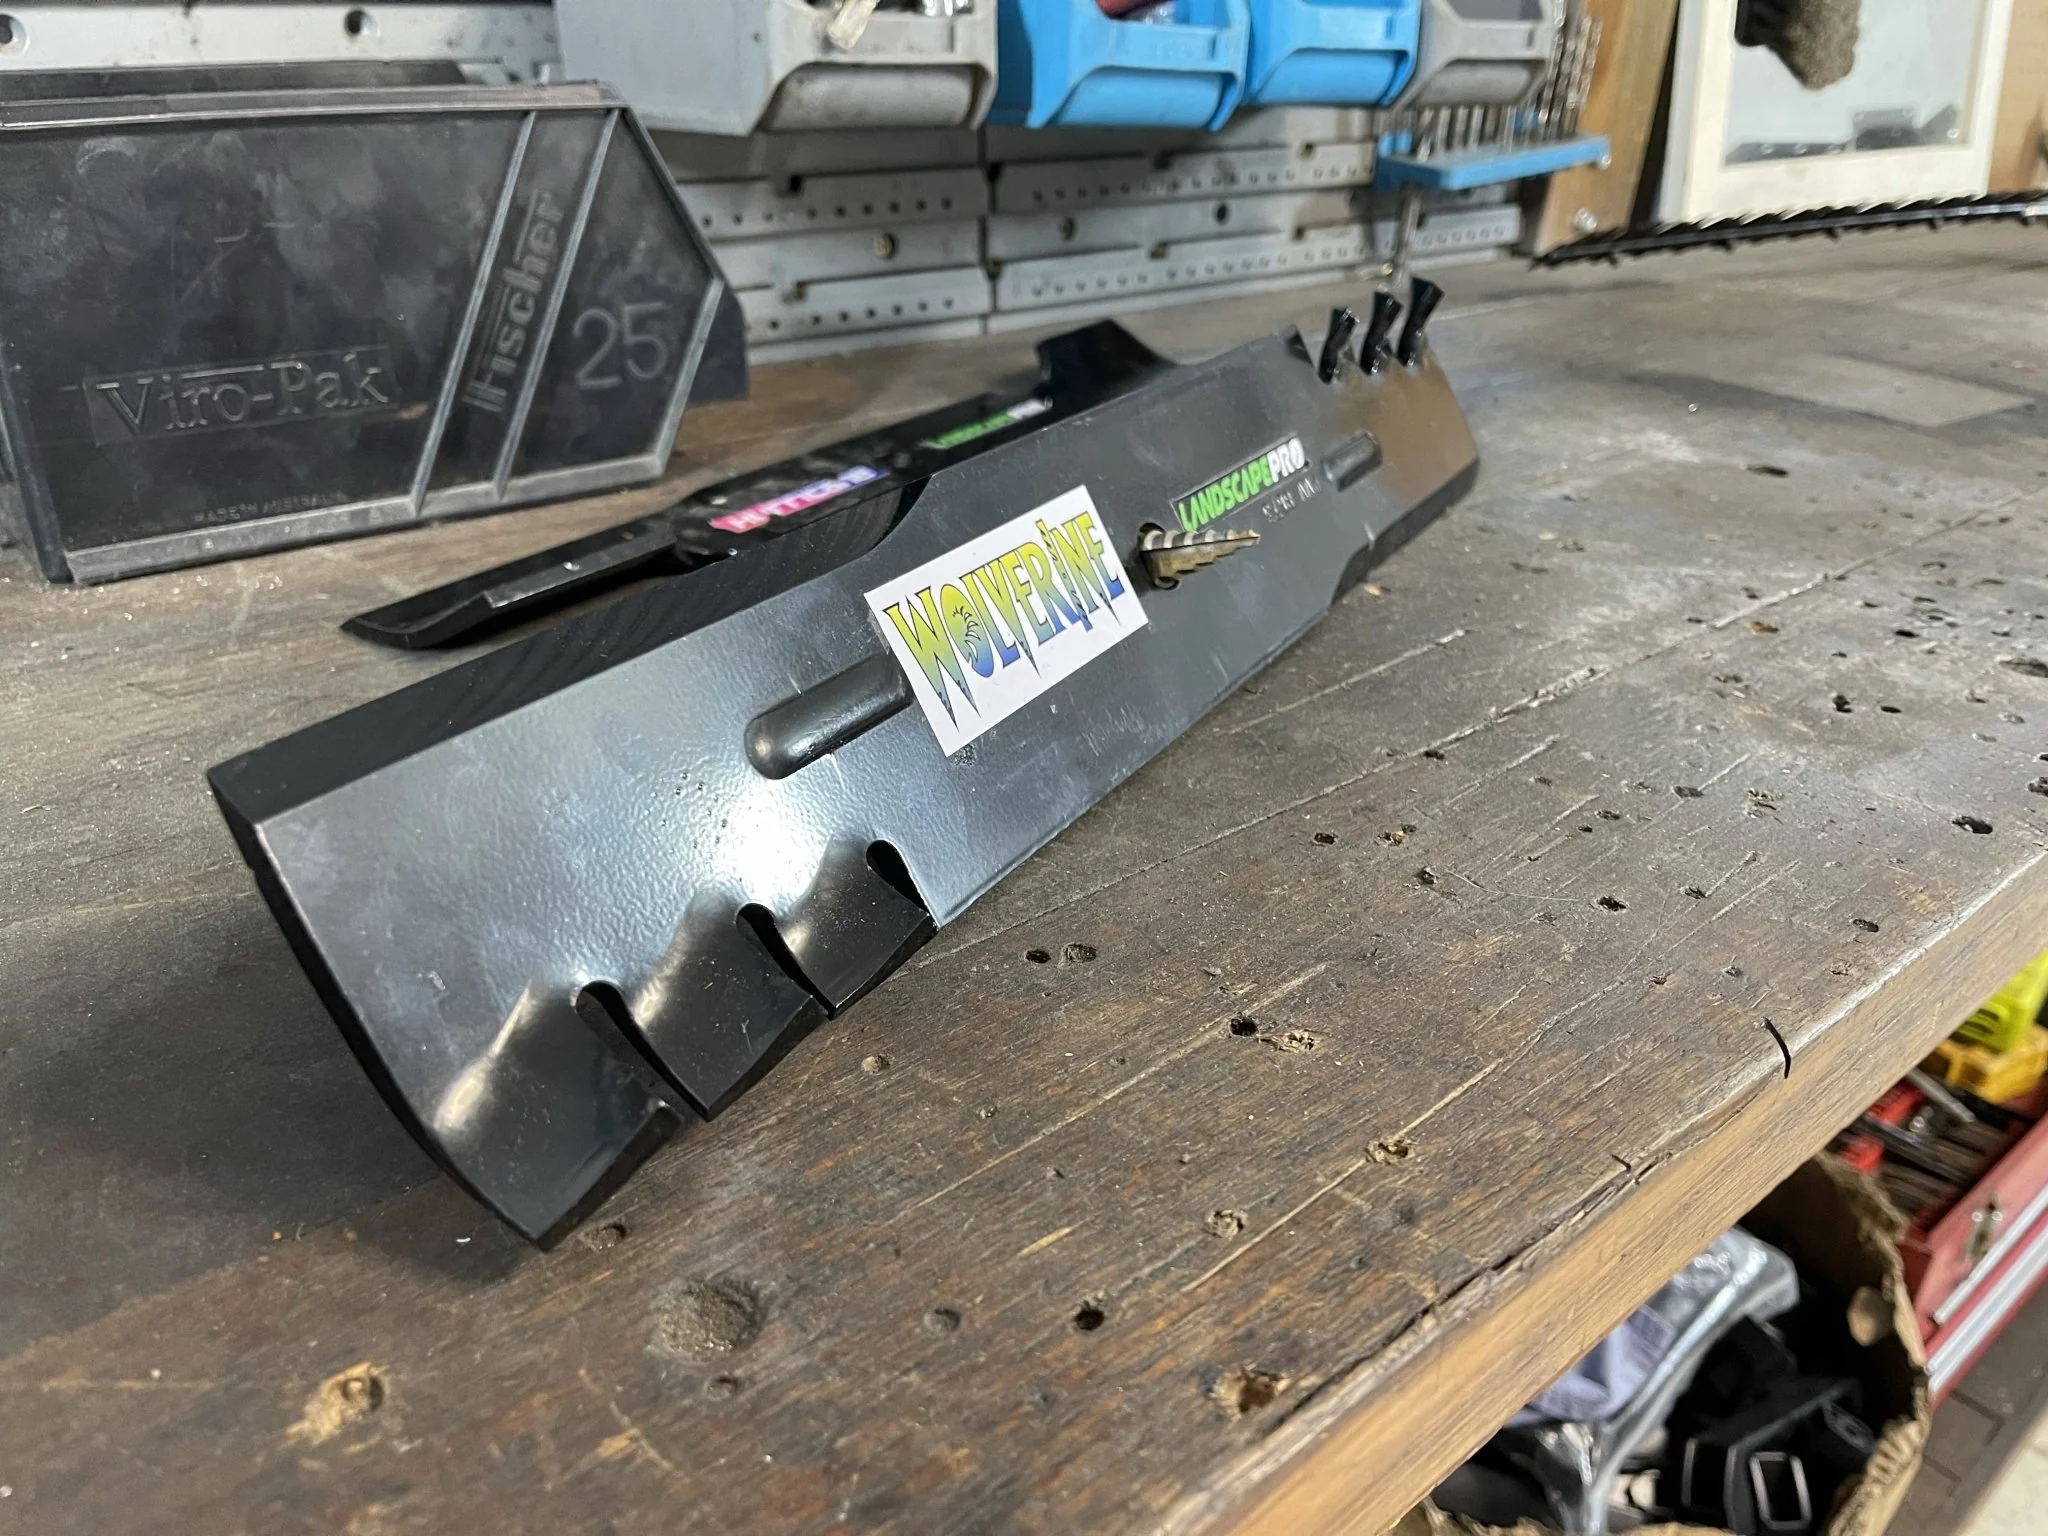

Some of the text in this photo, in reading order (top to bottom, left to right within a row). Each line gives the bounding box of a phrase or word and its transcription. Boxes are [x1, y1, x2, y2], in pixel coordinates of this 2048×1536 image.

[572, 301, 668, 391] 25
[95, 352, 390, 434] Viro-Pak
[1177, 437, 1306, 533] LANDSCAPEPRO
[882, 511, 1126, 733] WOLVERINE
